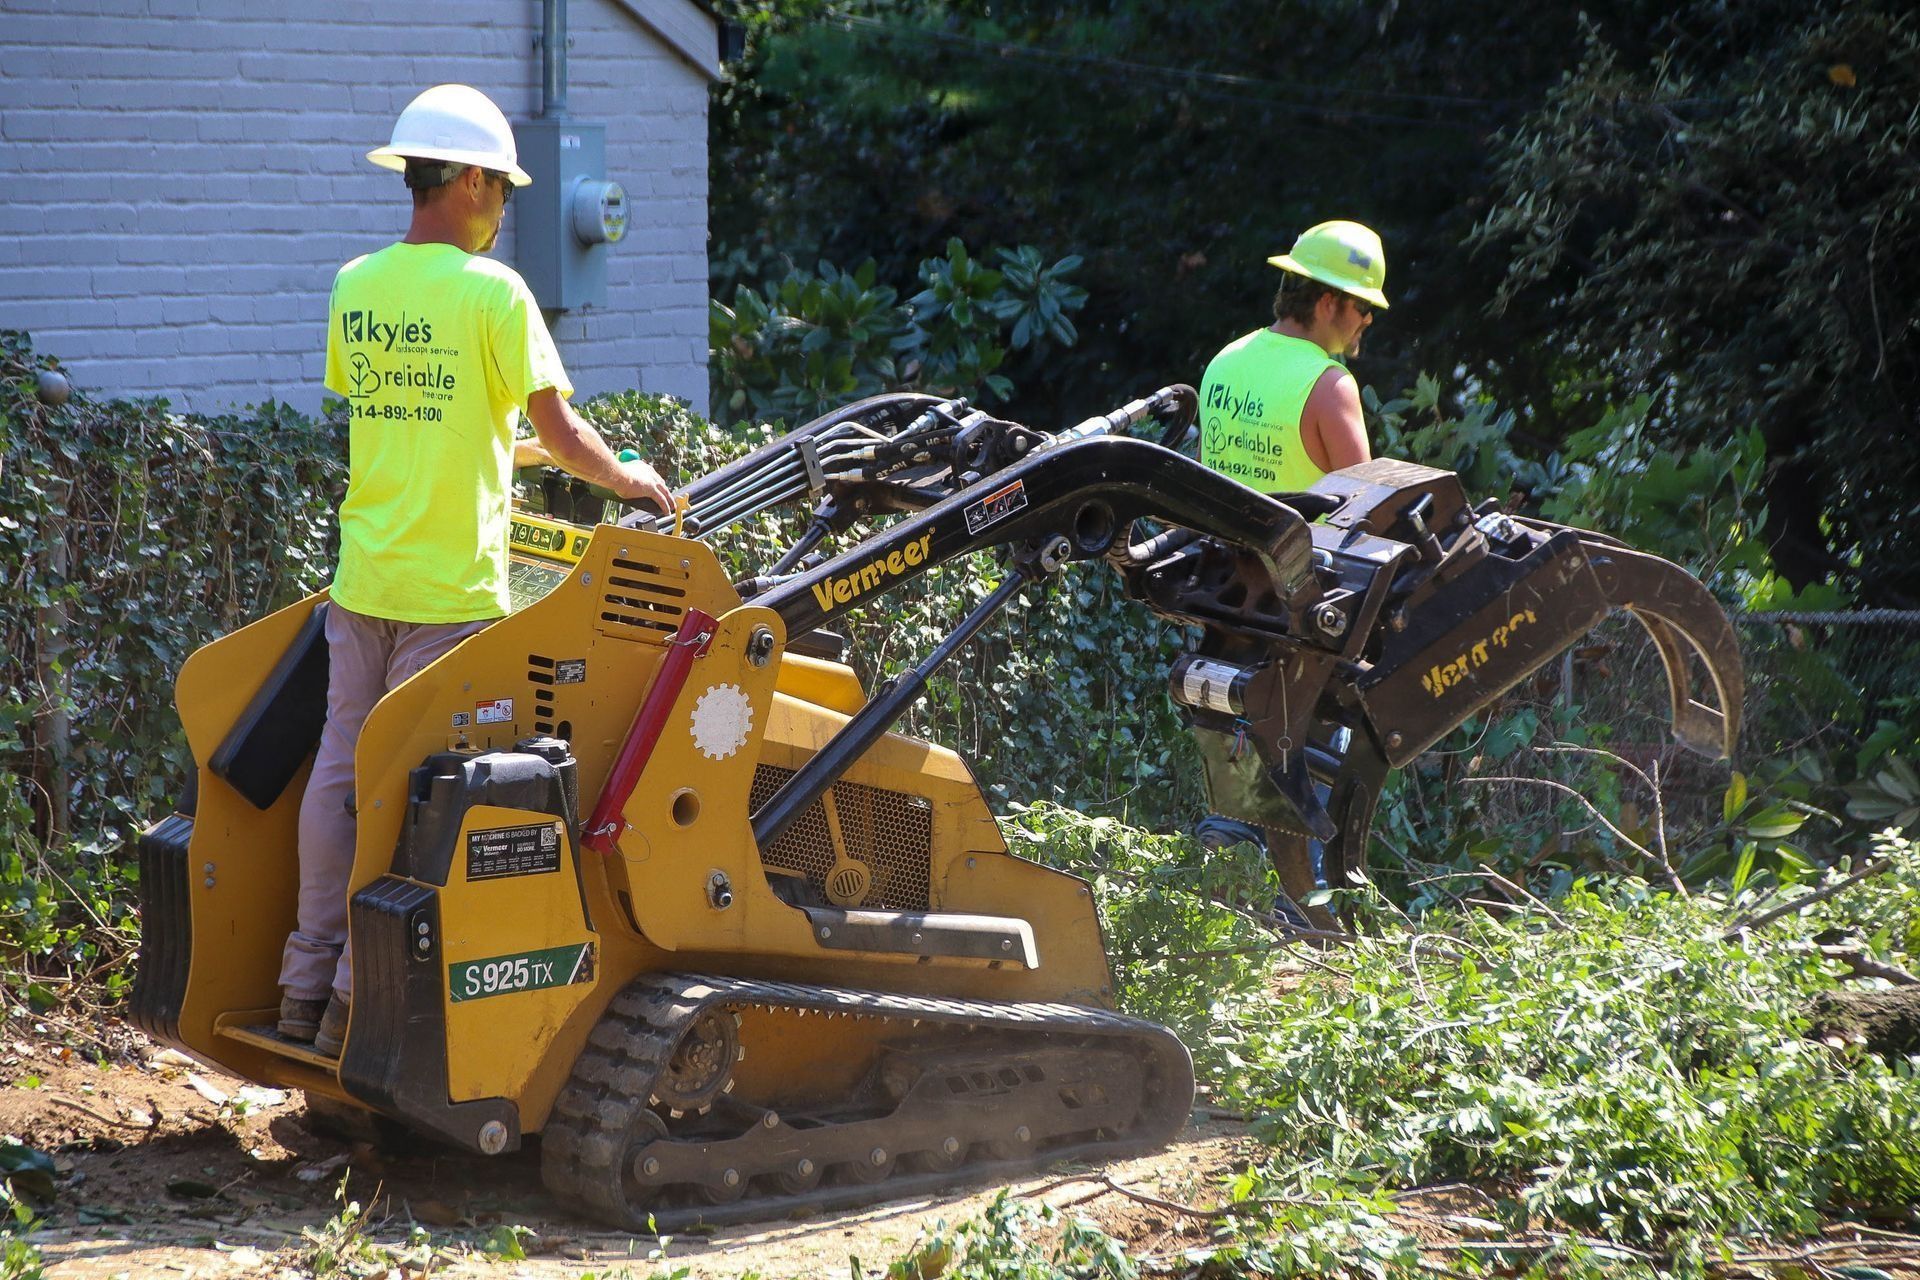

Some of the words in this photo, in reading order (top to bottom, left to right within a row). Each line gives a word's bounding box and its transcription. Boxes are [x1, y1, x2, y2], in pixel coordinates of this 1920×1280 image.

[367, 310, 432, 352] kyle's
[430, 346, 459, 356] service
[384, 362, 456, 390] reliable
[1222, 385, 1264, 420] kyle's
[1227, 430, 1283, 457] reliable
[471, 834, 481, 842] MY
[483, 844, 508, 853] Vermeer
